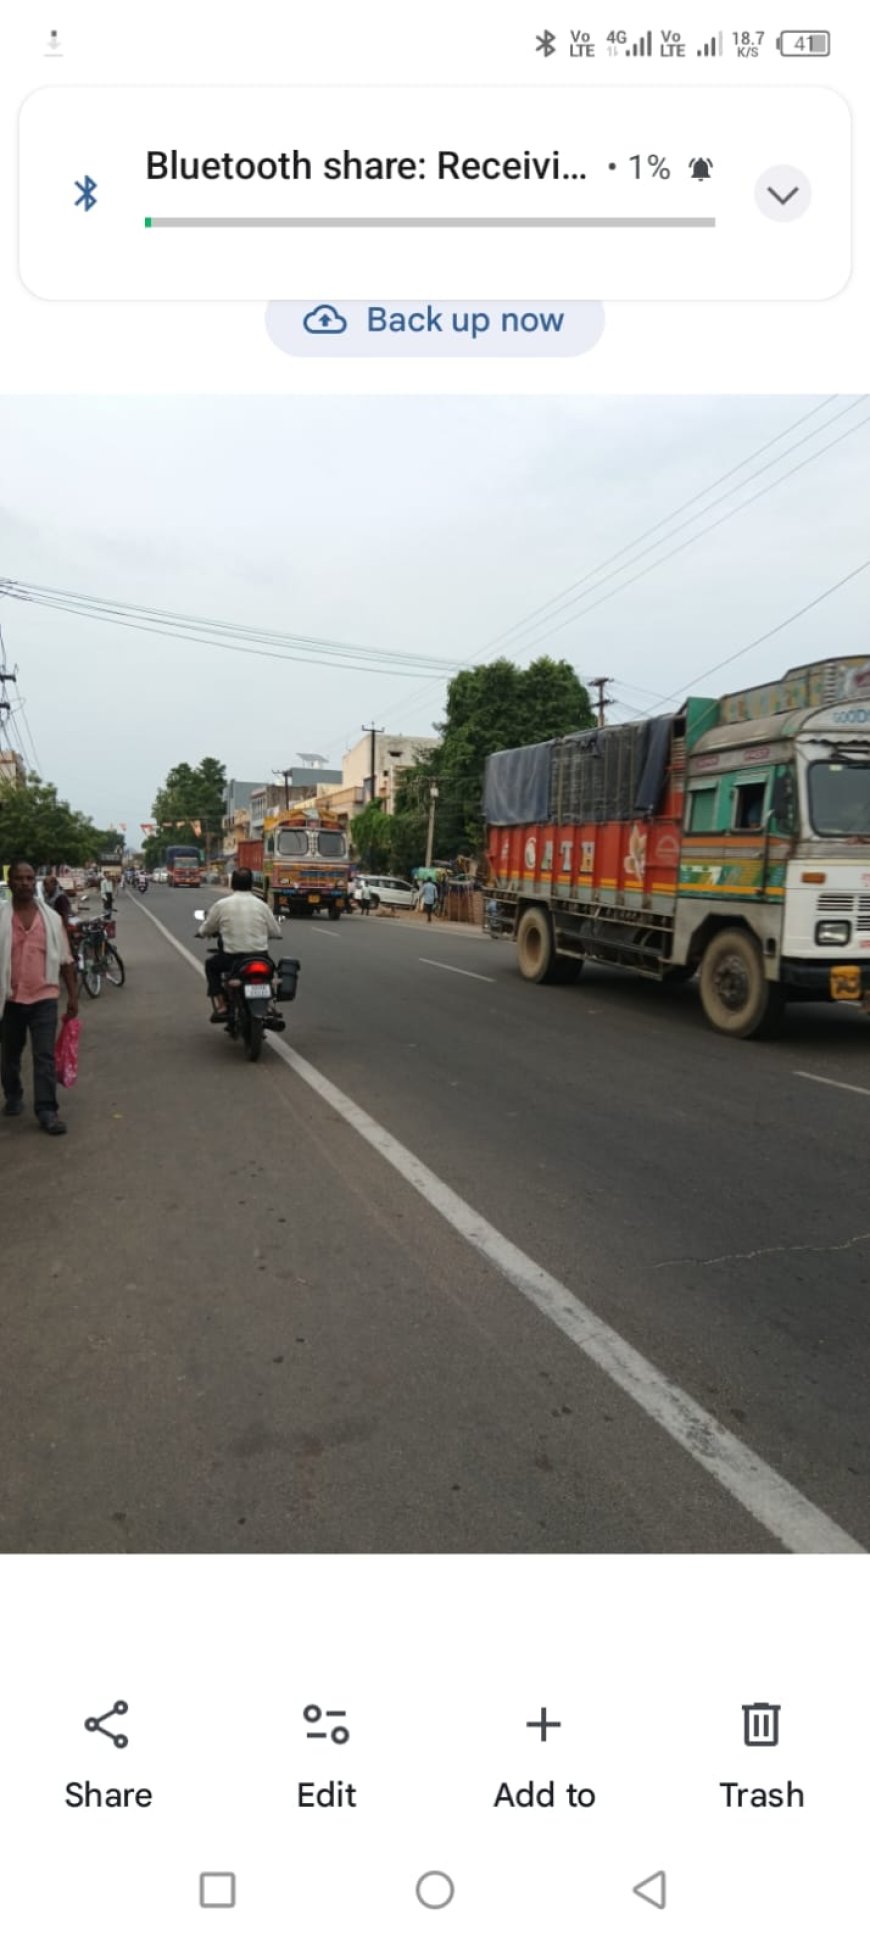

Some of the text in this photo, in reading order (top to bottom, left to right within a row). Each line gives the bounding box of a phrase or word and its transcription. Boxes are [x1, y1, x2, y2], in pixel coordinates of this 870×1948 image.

[570, 30, 590, 43] Vo
[606, 31, 627, 44] 4G
[661, 30, 681, 43] Vo
[732, 31, 765, 46] 18.7
[569, 44, 595, 57] LTE
[660, 44, 686, 57] LTE
[736, 46, 759, 58] K/S
[147, 149, 311, 181] Bluetooth
[323, 149, 425, 181] share:
[628, 154, 671, 180] 1%
[368, 305, 565, 340] Back up now
[65, 1780, 153, 1809] Share
[298, 1780, 358, 1809] Edit
[493, 1780, 596, 1809] Add to
[719, 1780, 805, 1809] Trash
